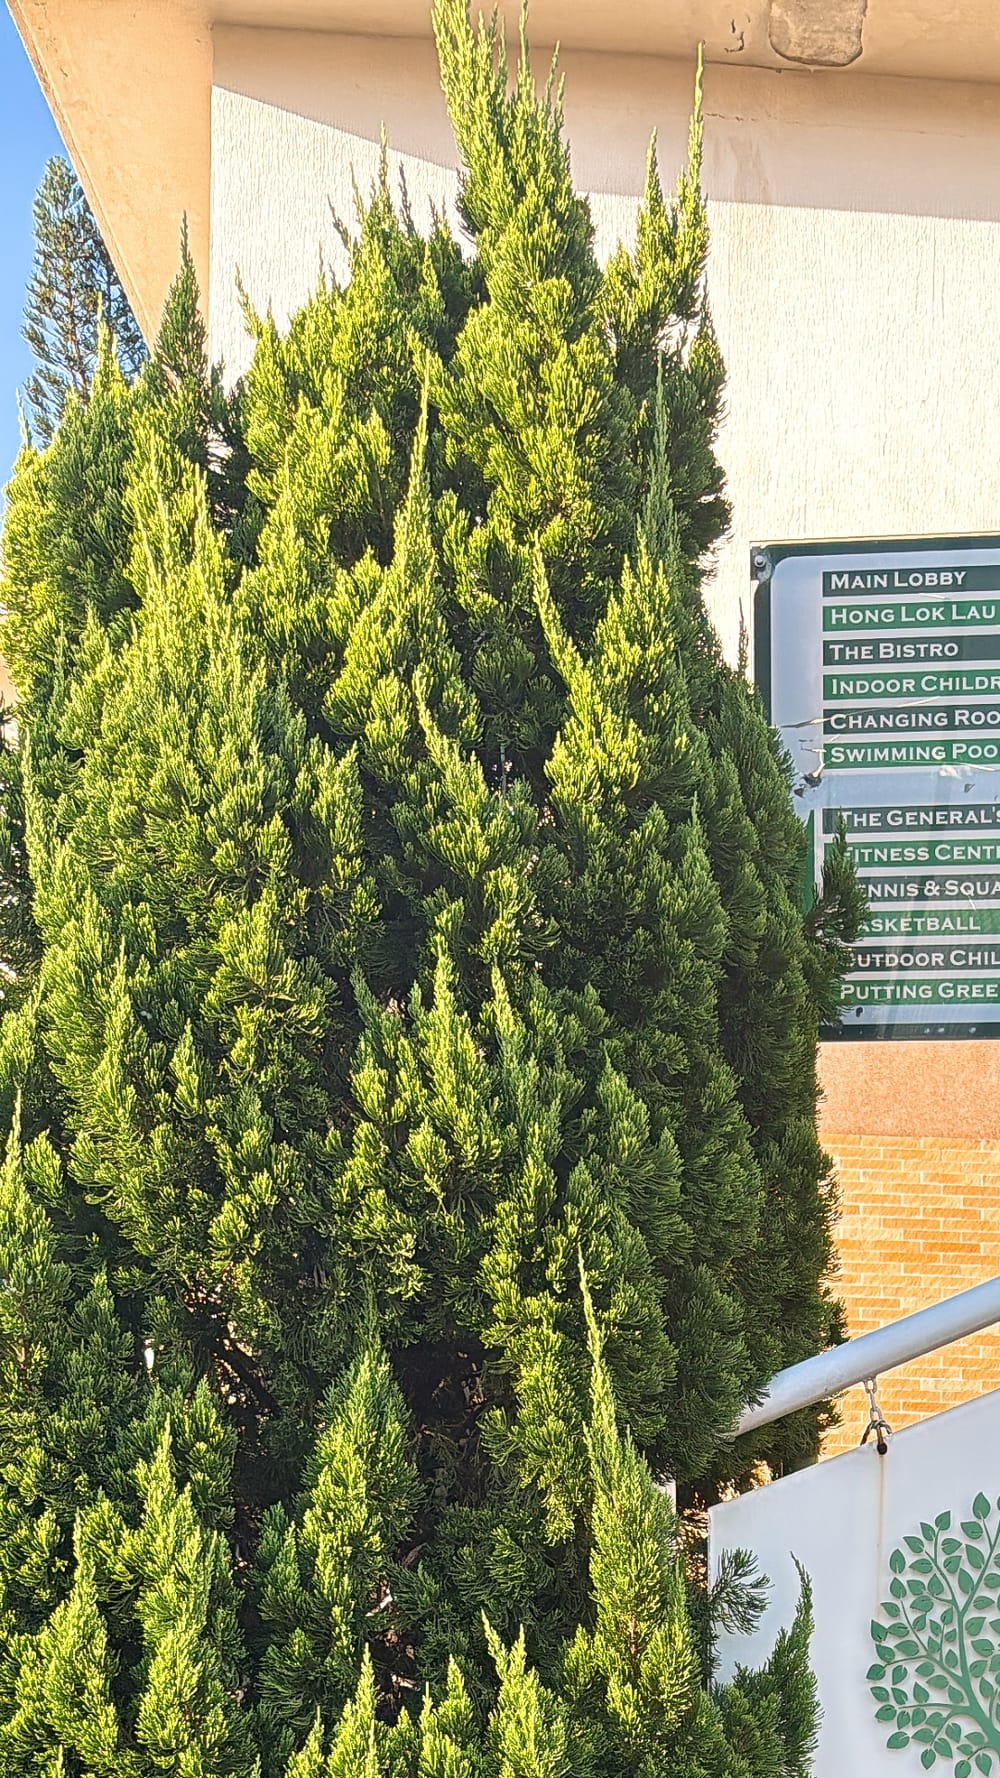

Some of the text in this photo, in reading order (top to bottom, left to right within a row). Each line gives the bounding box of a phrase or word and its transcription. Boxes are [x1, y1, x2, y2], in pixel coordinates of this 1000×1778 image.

[831, 571, 967, 590] MAIN LOBBY
[831, 608, 895, 625] HONG
[901, 605, 945, 622] LOK
[952, 604, 996, 620] LAU
[829, 642, 959, 661] THE BISTRO
[831, 678, 916, 695] INDOOR
[830, 712, 948, 730] CHANGING
[831, 746, 946, 763] SWIMMING
[838, 810, 882, 827] THE
[857, 883, 919, 898] NNIS
[924, 880, 941, 896] &
[857, 916, 981, 933] ASKETBALL
[840, 984, 932, 1000] PUTTING
